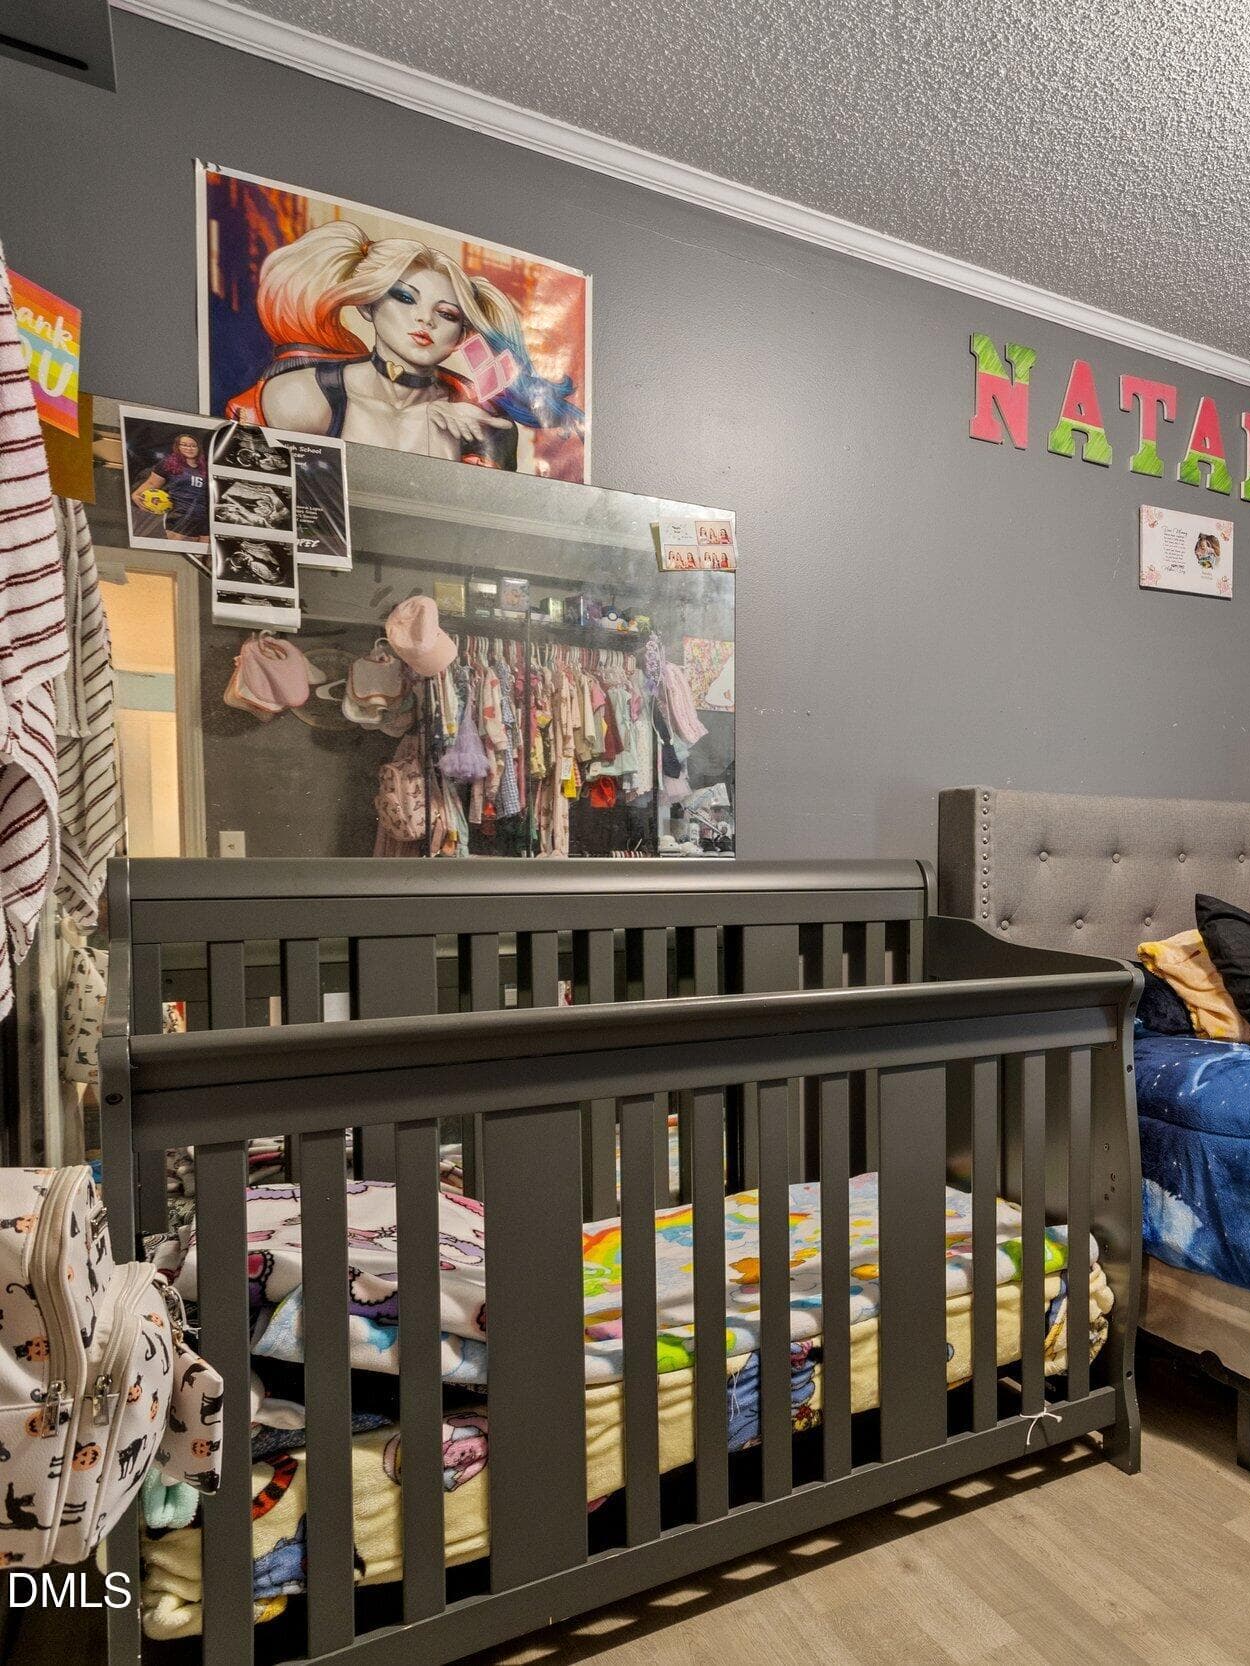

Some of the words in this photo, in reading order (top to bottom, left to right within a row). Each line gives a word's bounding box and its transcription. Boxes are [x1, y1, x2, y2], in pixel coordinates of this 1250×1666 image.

[16, 306, 73, 351] ank
[299, 446, 322, 455] School
[191, 475, 204, 488] 16
